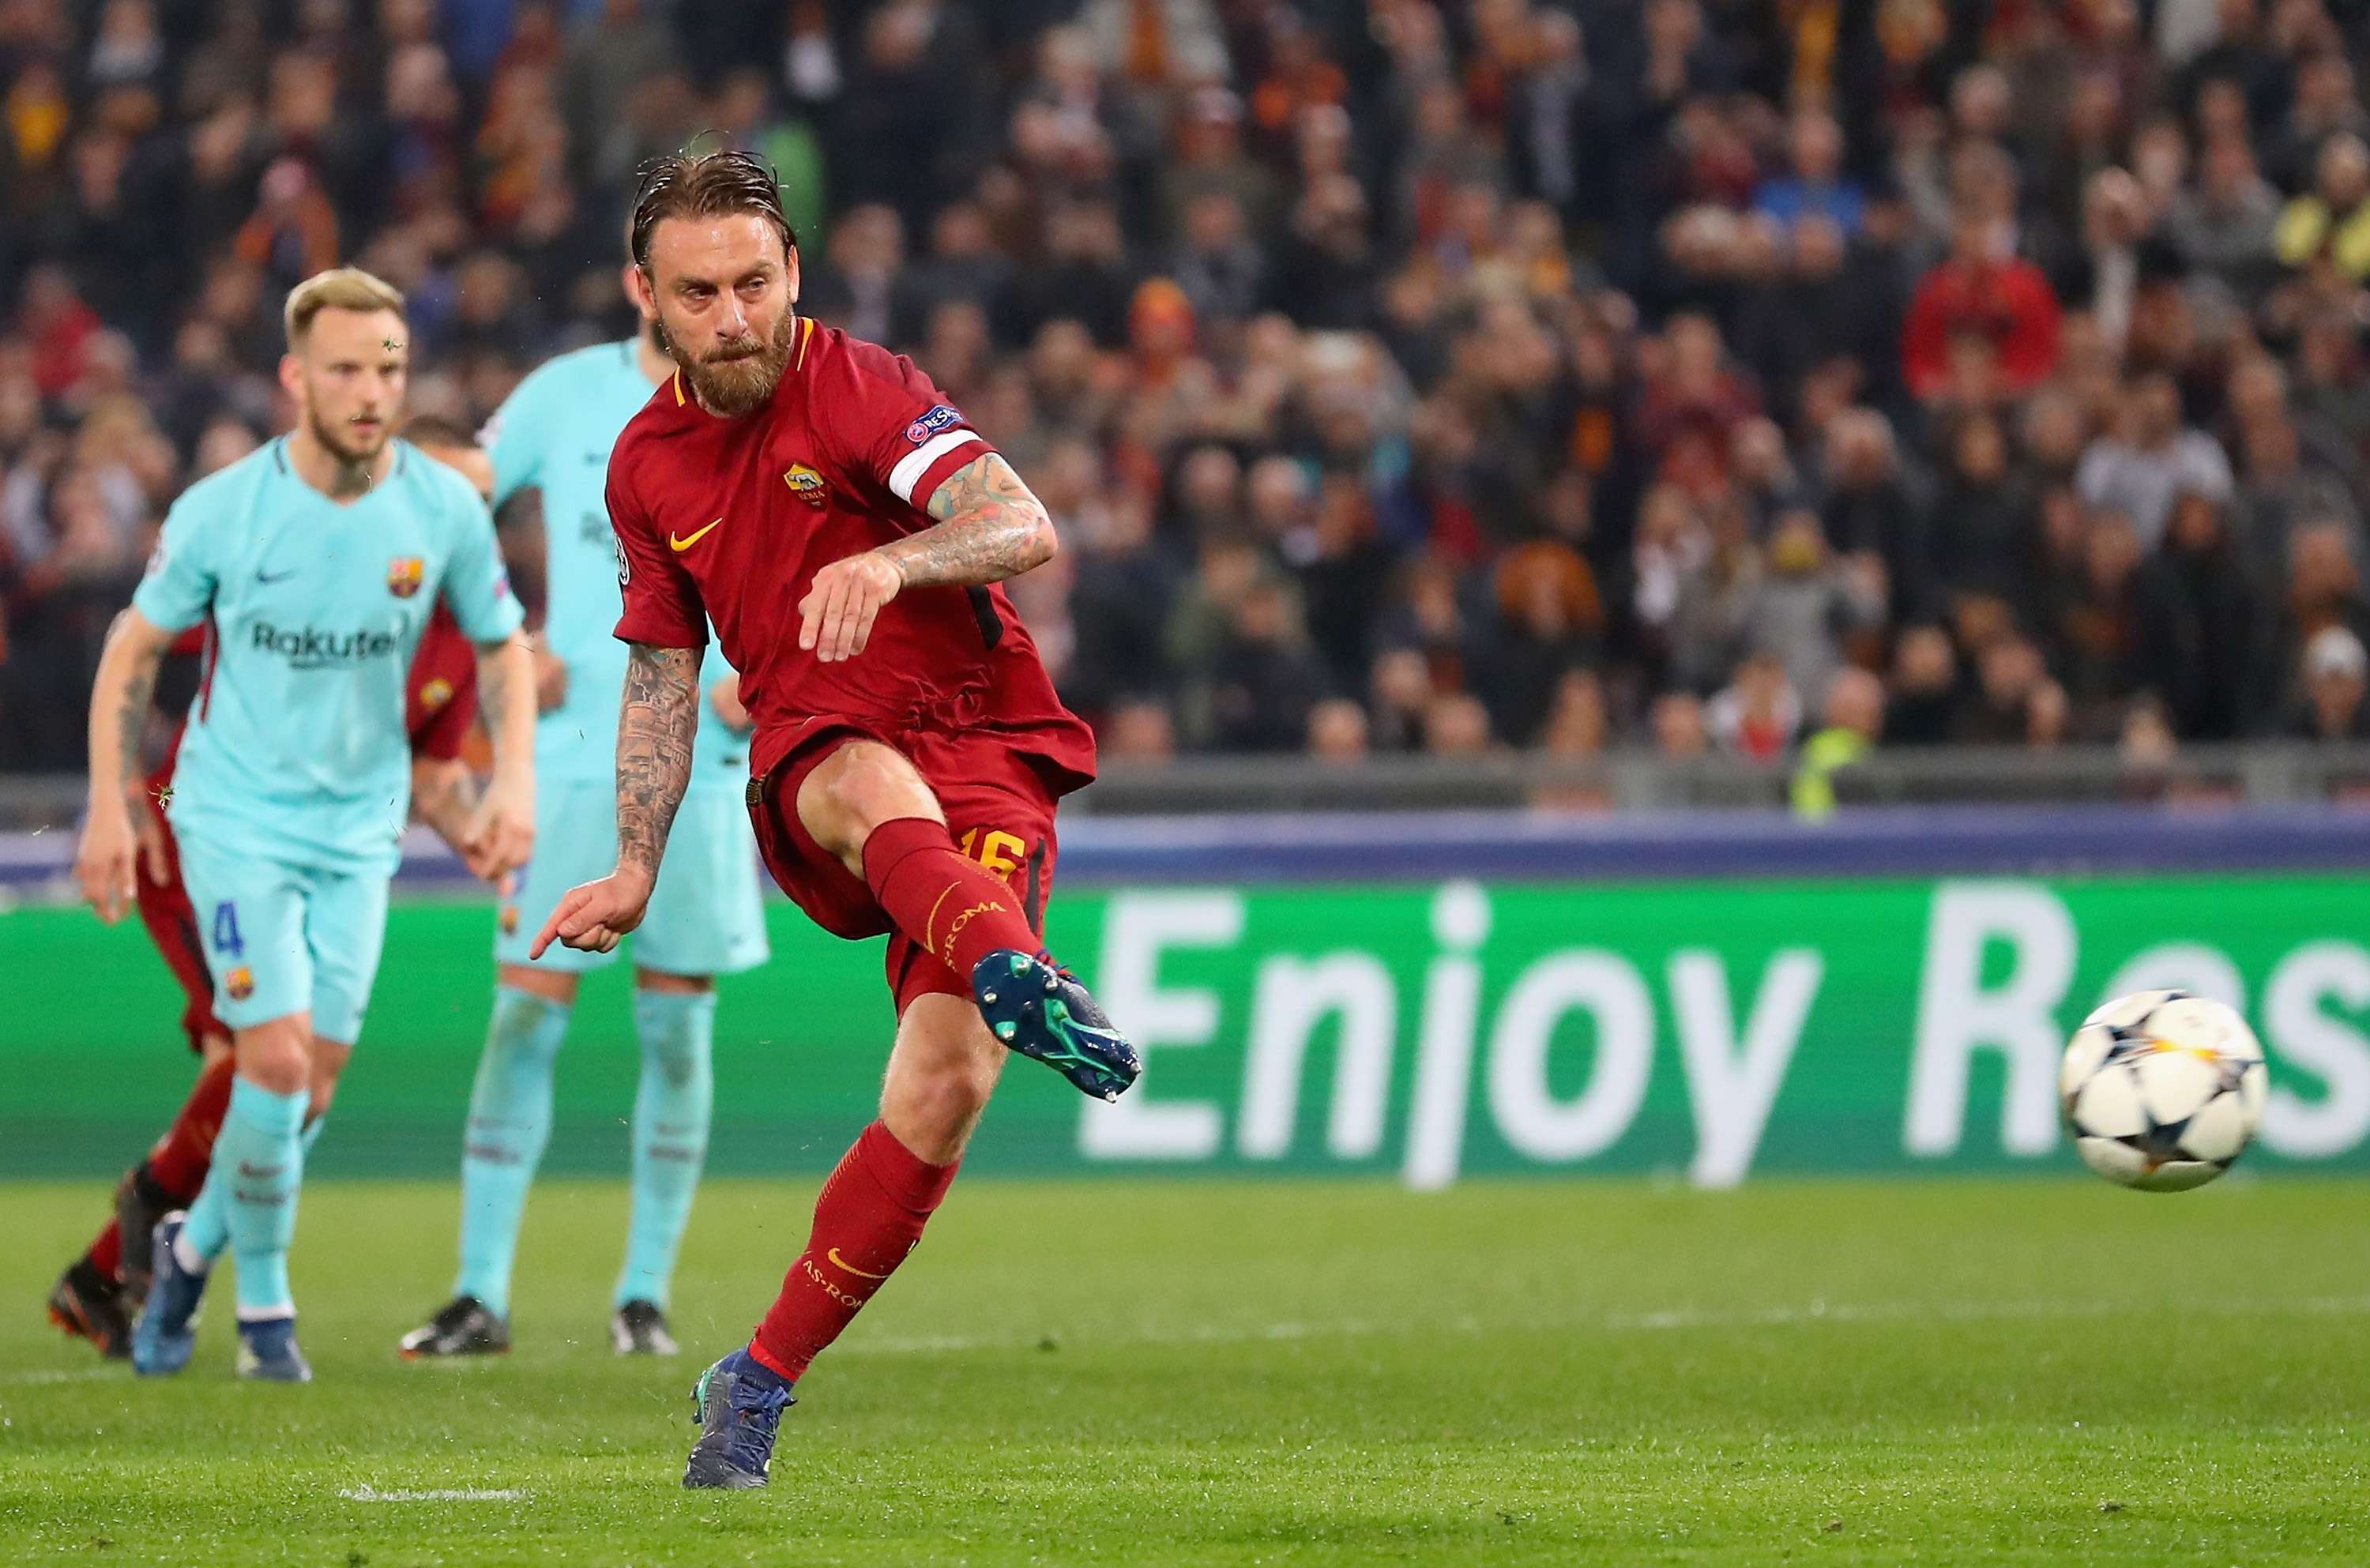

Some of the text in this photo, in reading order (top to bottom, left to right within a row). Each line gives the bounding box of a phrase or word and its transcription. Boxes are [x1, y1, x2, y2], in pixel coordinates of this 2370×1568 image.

[252, 620, 397, 660] Rakute
[961, 828, 1025, 882] 16
[214, 902, 244, 958] 4
[1079, 878, 2370, 1190] Enjoy Rs
